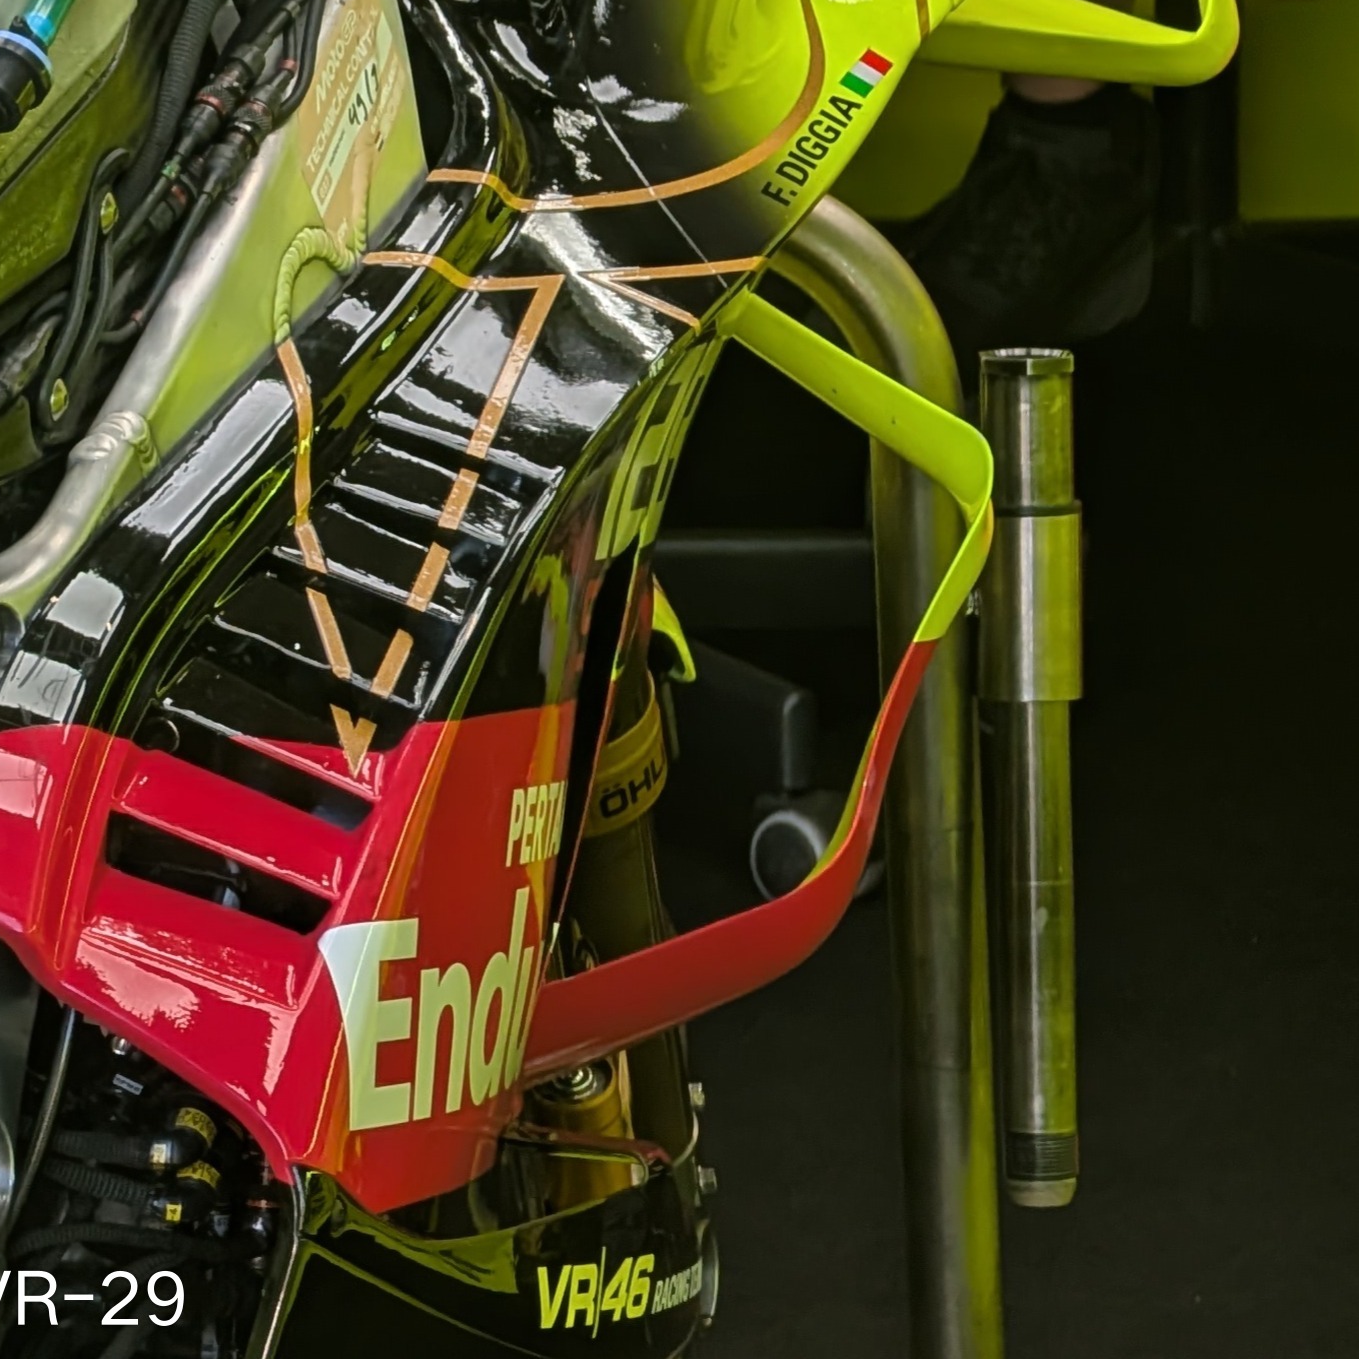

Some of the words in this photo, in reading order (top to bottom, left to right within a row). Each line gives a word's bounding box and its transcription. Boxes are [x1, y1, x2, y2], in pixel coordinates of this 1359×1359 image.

[306, 80, 349, 172] TECHNICAL
[775, 95, 863, 187] DIGGIA
[761, 181, 798, 207] F.
